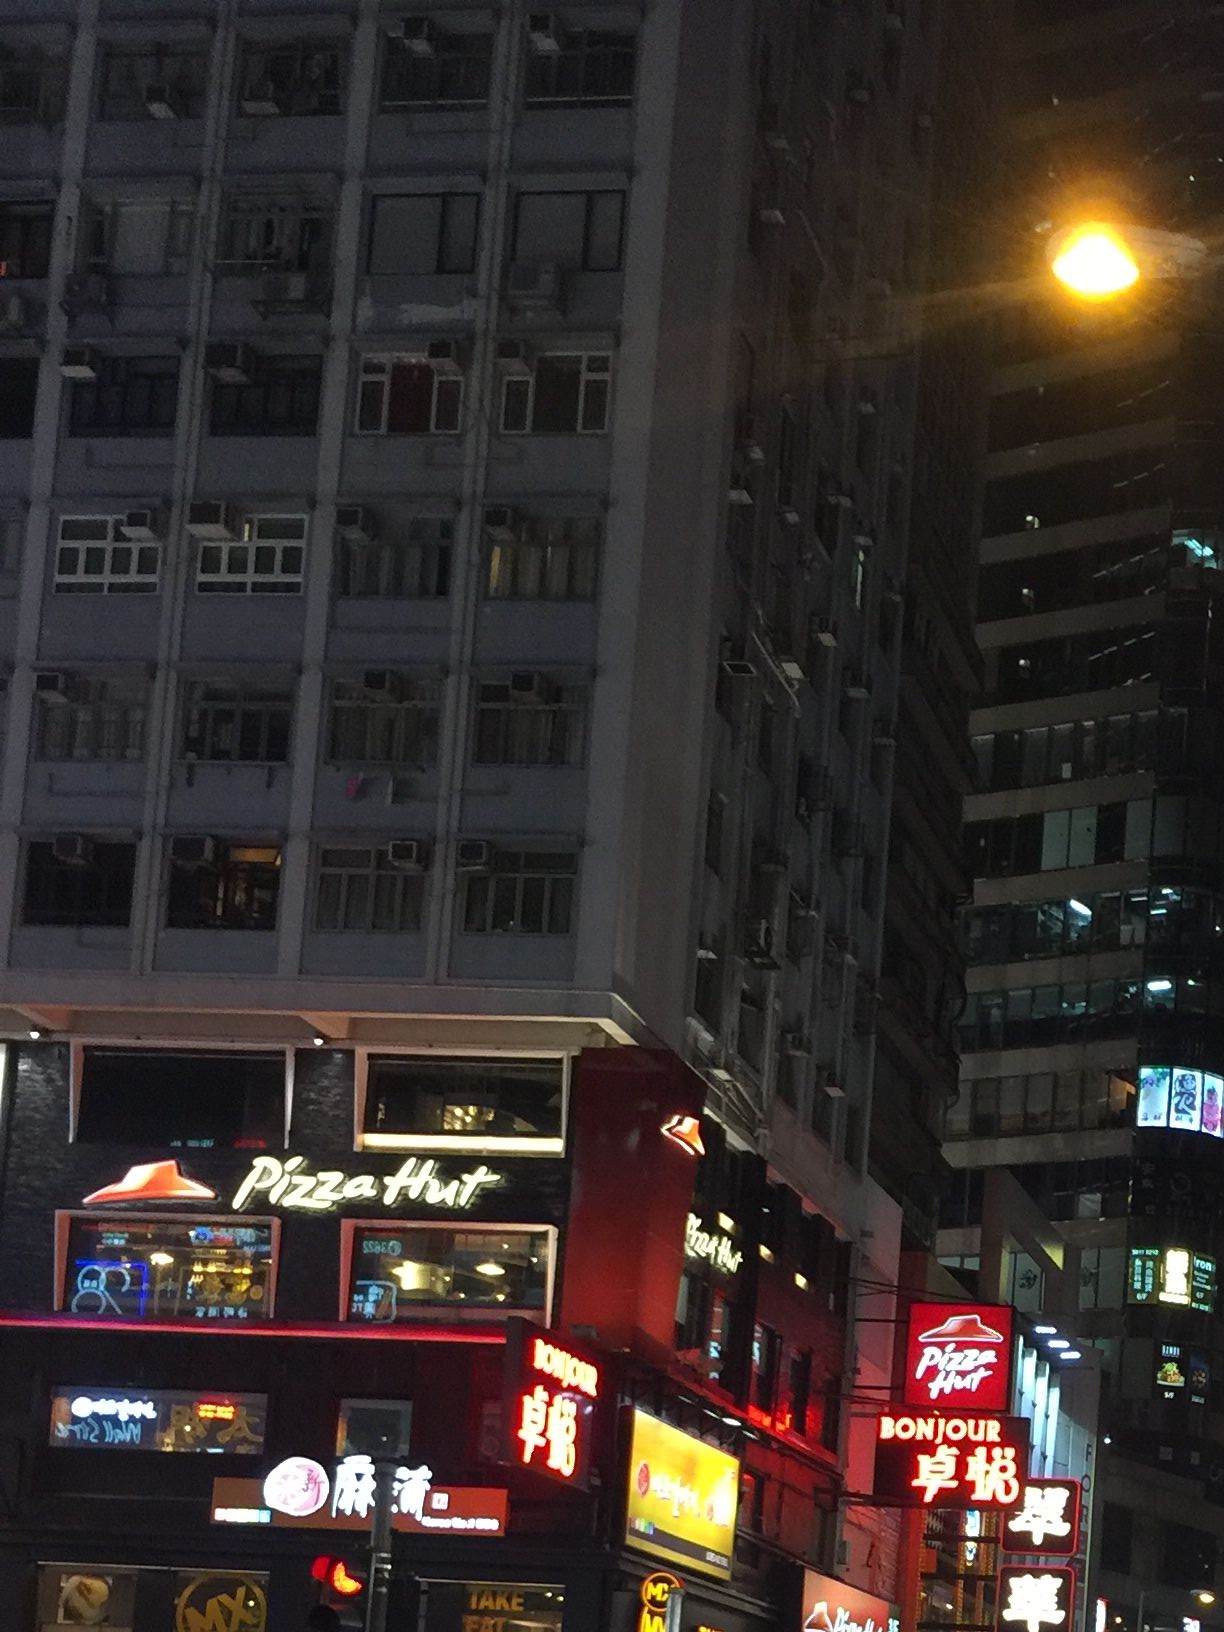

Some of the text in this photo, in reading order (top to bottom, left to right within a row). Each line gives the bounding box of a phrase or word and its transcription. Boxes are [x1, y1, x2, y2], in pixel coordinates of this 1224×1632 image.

[232, 1156, 501, 1210] Pizza Hut
[717, 1236, 744, 1274] Hut
[533, 1338, 598, 1396] BONJOUR
[915, 1342, 998, 1380] Pizza
[928, 1366, 993, 1400] Hut
[880, 1410, 1001, 1445] BONJOUR
